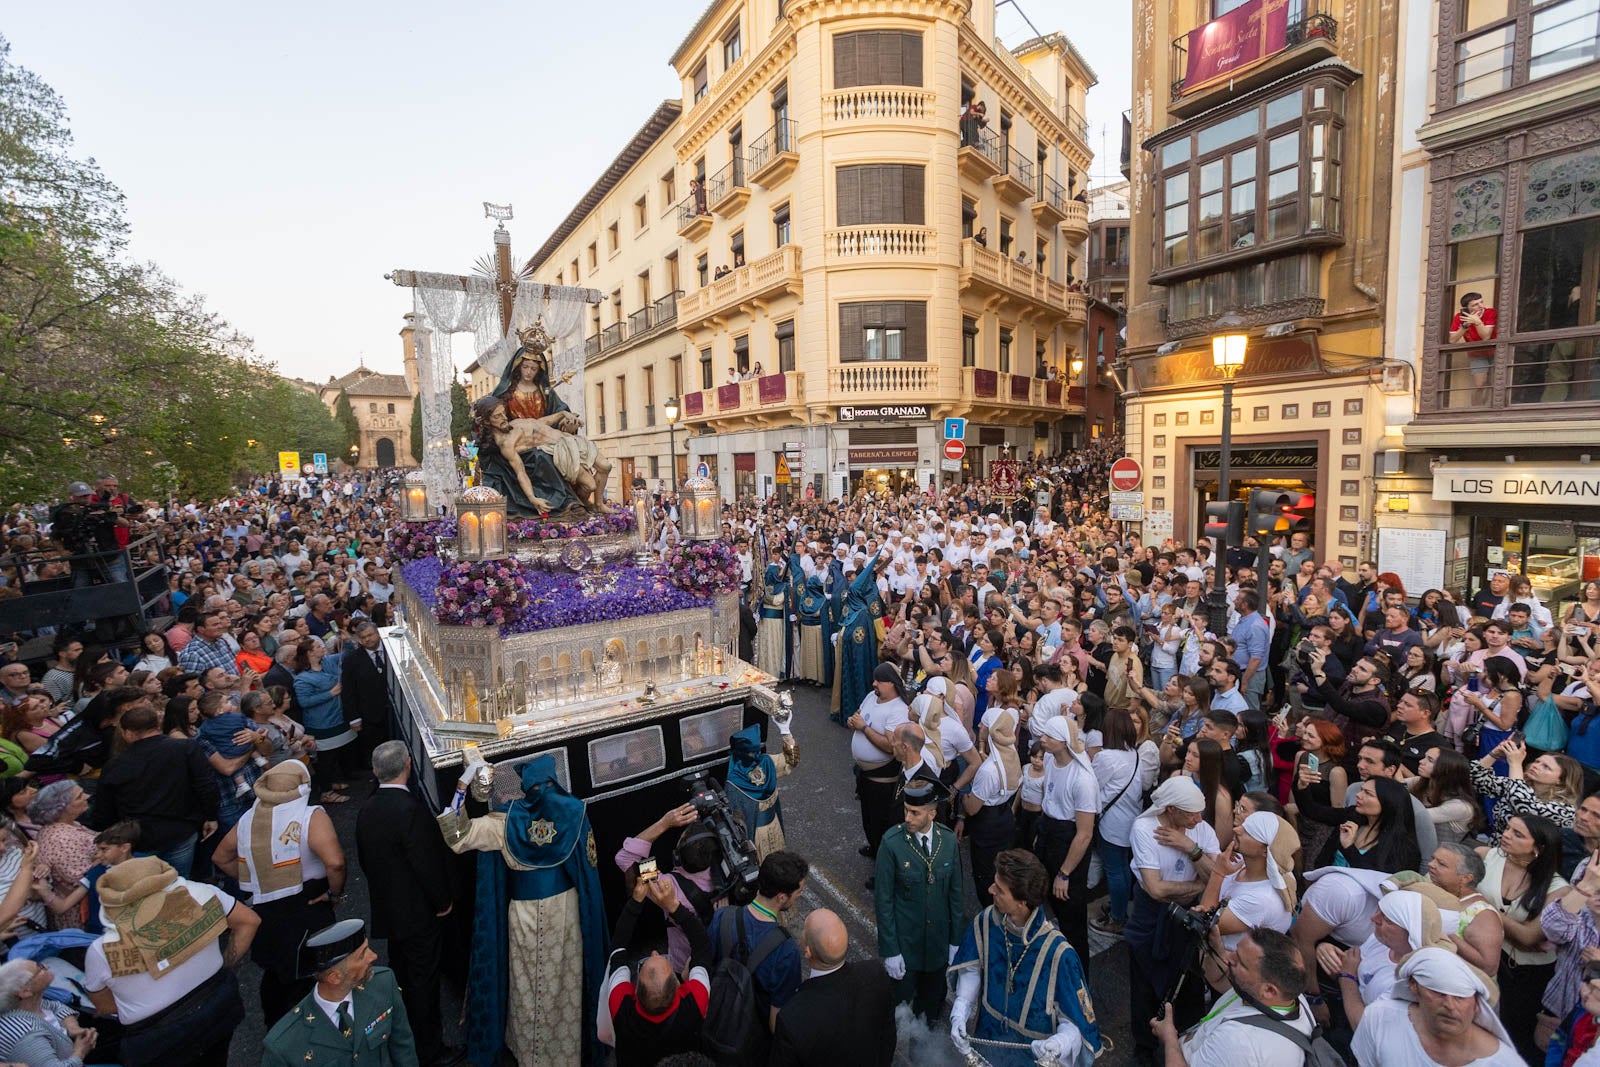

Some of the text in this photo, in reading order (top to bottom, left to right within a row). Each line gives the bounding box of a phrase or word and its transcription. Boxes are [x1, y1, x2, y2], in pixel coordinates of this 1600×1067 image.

[880, 407, 926, 416] GRANADA
[1244, 450, 1314, 465] Taberna
[1451, 479, 1600, 496] LOS DIAMAN
